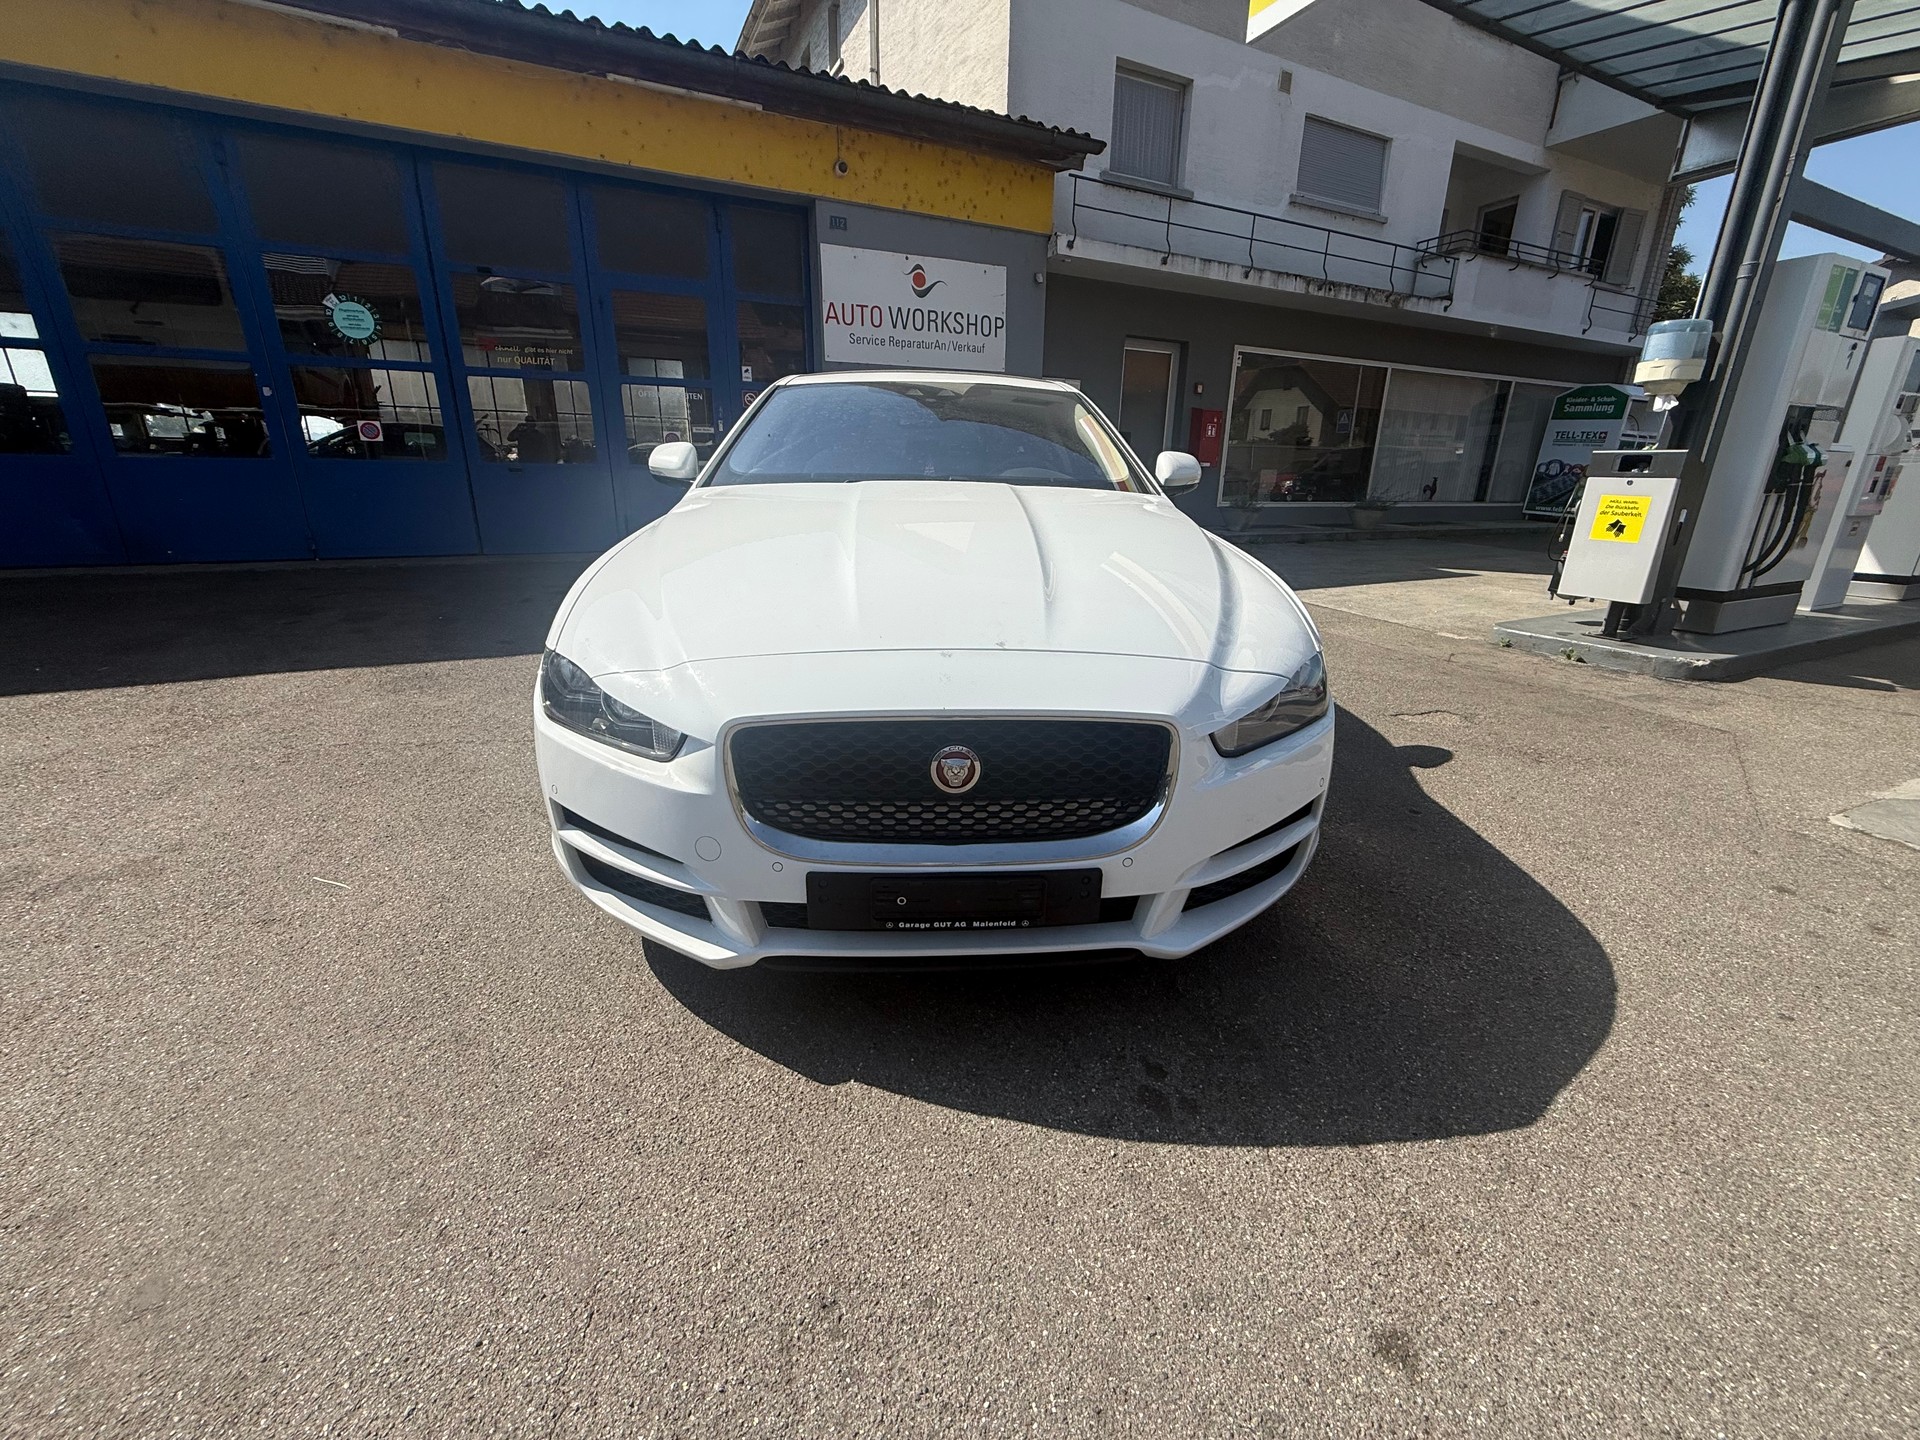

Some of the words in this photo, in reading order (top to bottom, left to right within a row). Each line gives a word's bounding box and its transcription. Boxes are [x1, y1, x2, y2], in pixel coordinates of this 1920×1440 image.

[831, 217, 845, 228] 112
[825, 301, 883, 328] AUTO
[888, 305, 1005, 338] WORKSHOP
[849, 332, 886, 347] Service
[888, 335, 986, 354] ReparaturAn/Verkauf
[558, 347, 573, 355] nicht
[514, 355, 556, 366] QUALITÄT
[1563, 403, 1615, 414] Sammlung
[1555, 431, 1600, 439] TELL-TEX
[898, 921, 931, 929] Garage
